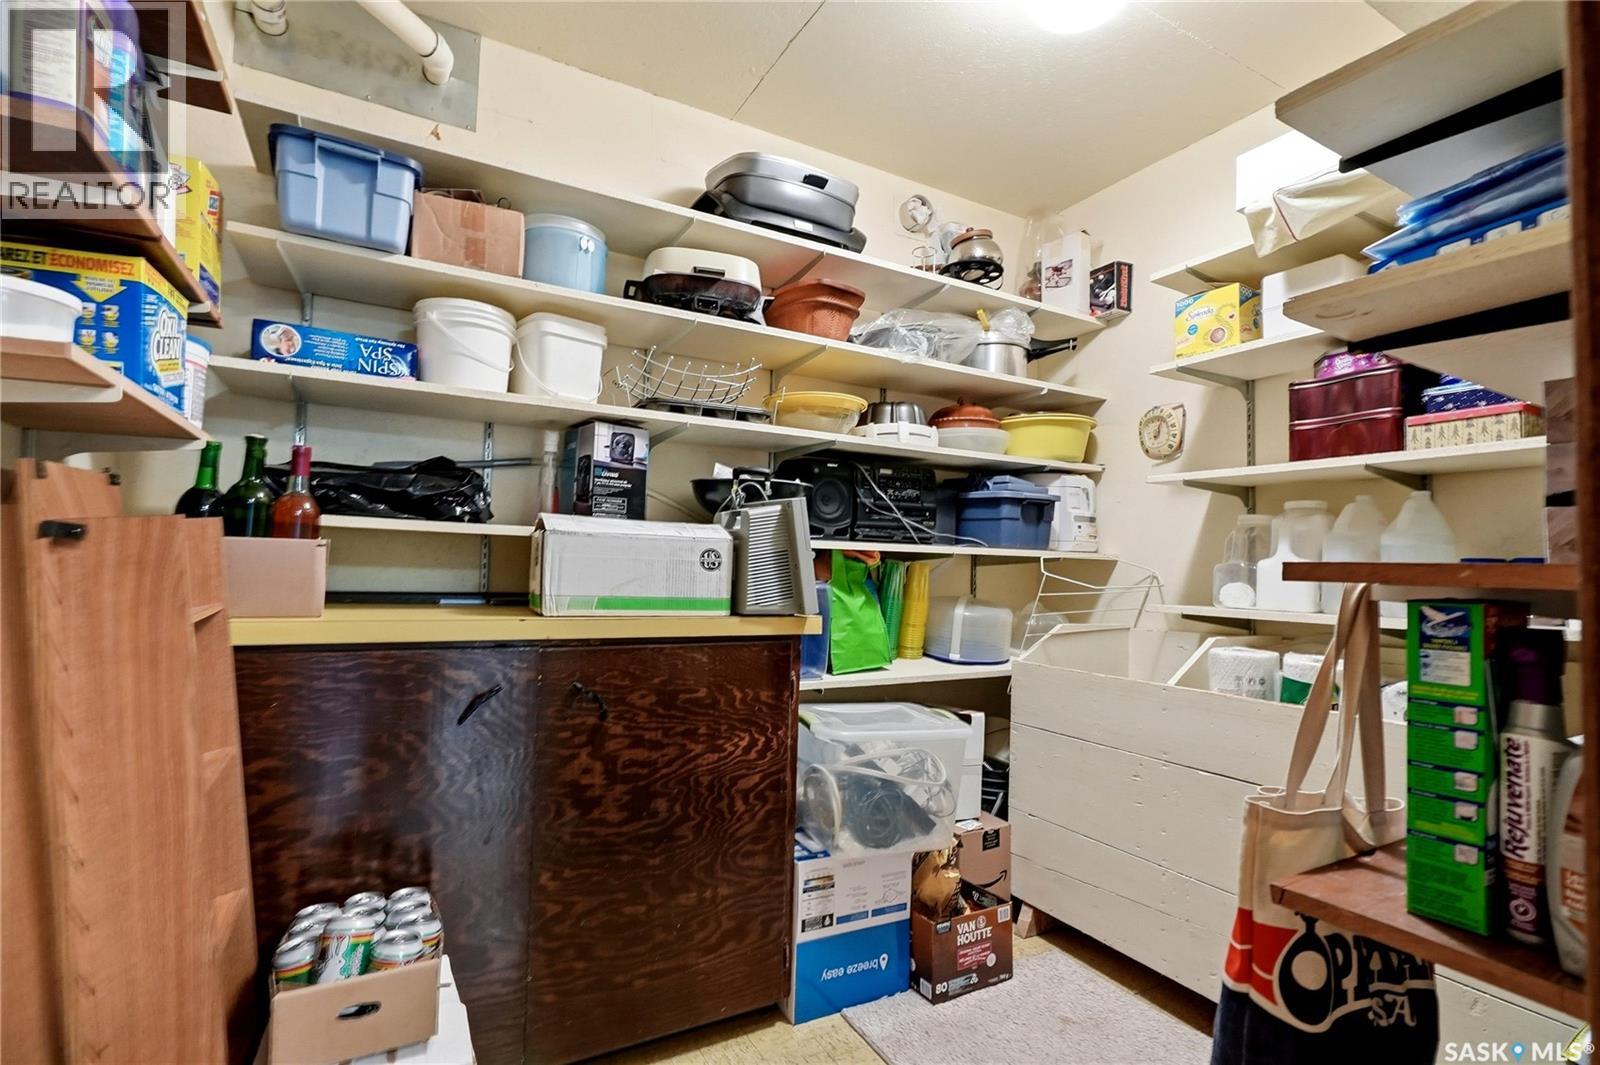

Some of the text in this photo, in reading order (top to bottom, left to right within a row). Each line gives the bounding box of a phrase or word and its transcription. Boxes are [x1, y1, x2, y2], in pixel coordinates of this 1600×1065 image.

[360, 344, 392, 361] SPA
[357, 358, 401, 376] SPIN
[1504, 737, 1530, 859] Rejuvenate
[956, 921, 976, 935] VAN
[956, 927, 993, 946] HOUTTE
[820, 958, 879, 981] breeze easy
[936, 981, 948, 995] 80
